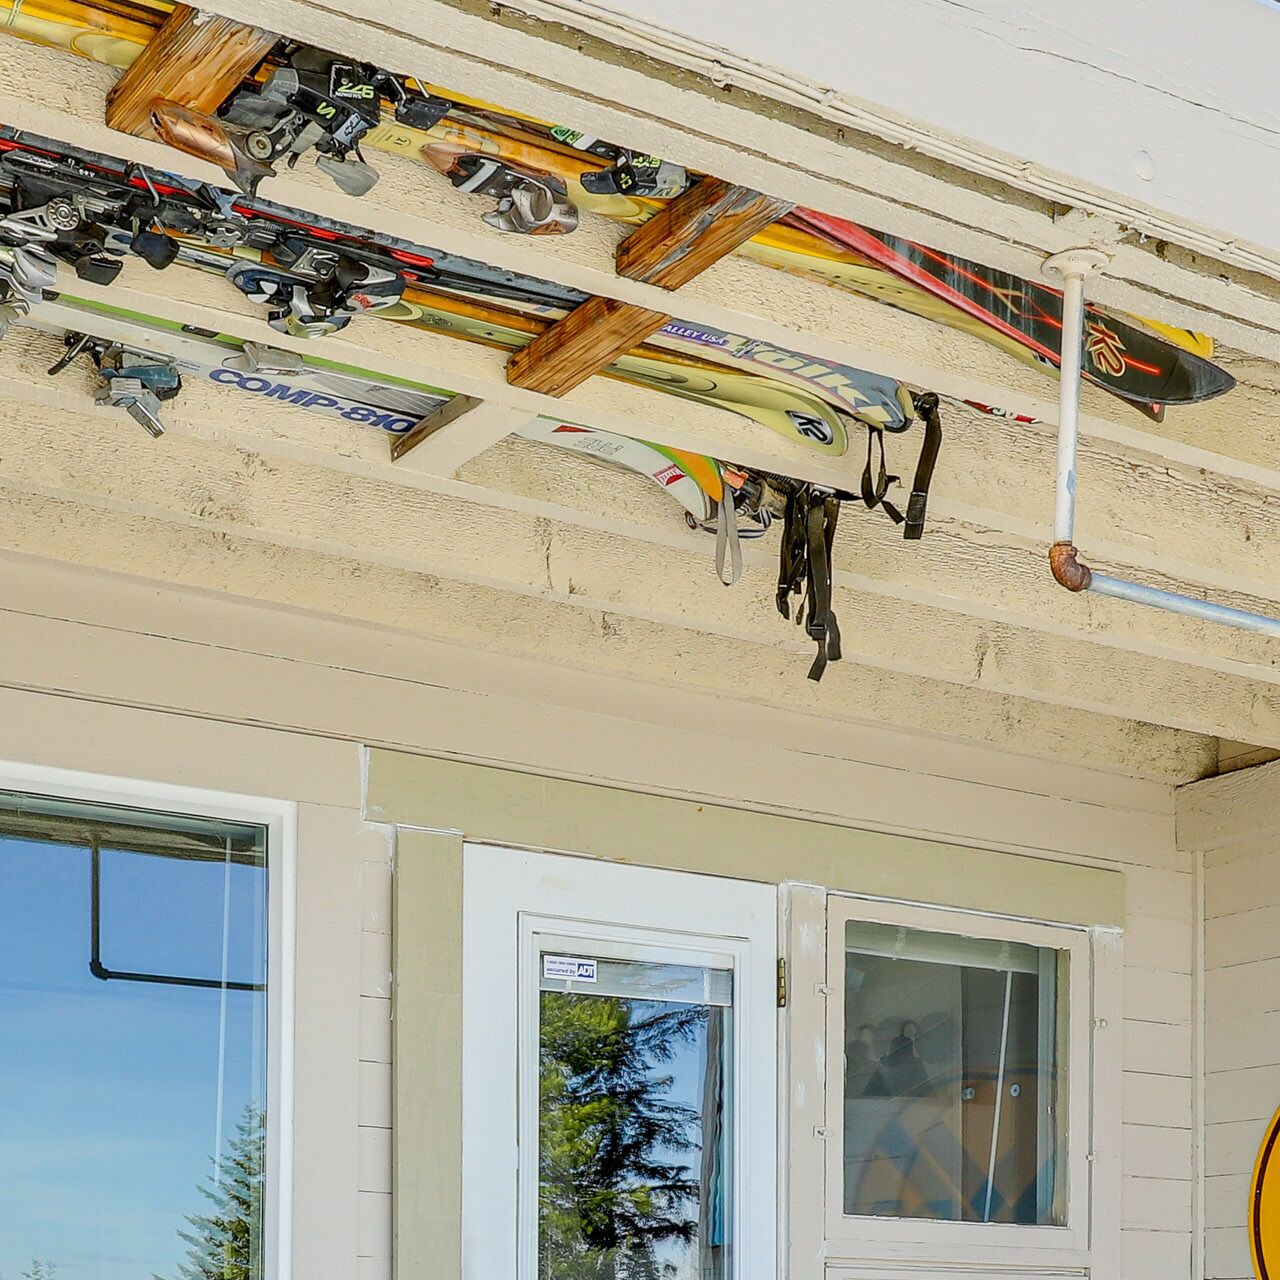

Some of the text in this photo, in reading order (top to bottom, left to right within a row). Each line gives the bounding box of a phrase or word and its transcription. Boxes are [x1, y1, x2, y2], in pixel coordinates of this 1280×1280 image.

[663, 324, 725, 346] ALLEY USA
[1086, 320, 1126, 377] K2
[208, 368, 418, 433] COMP-810
[789, 412, 832, 445] K2
[578, 965, 594, 977] ADT
